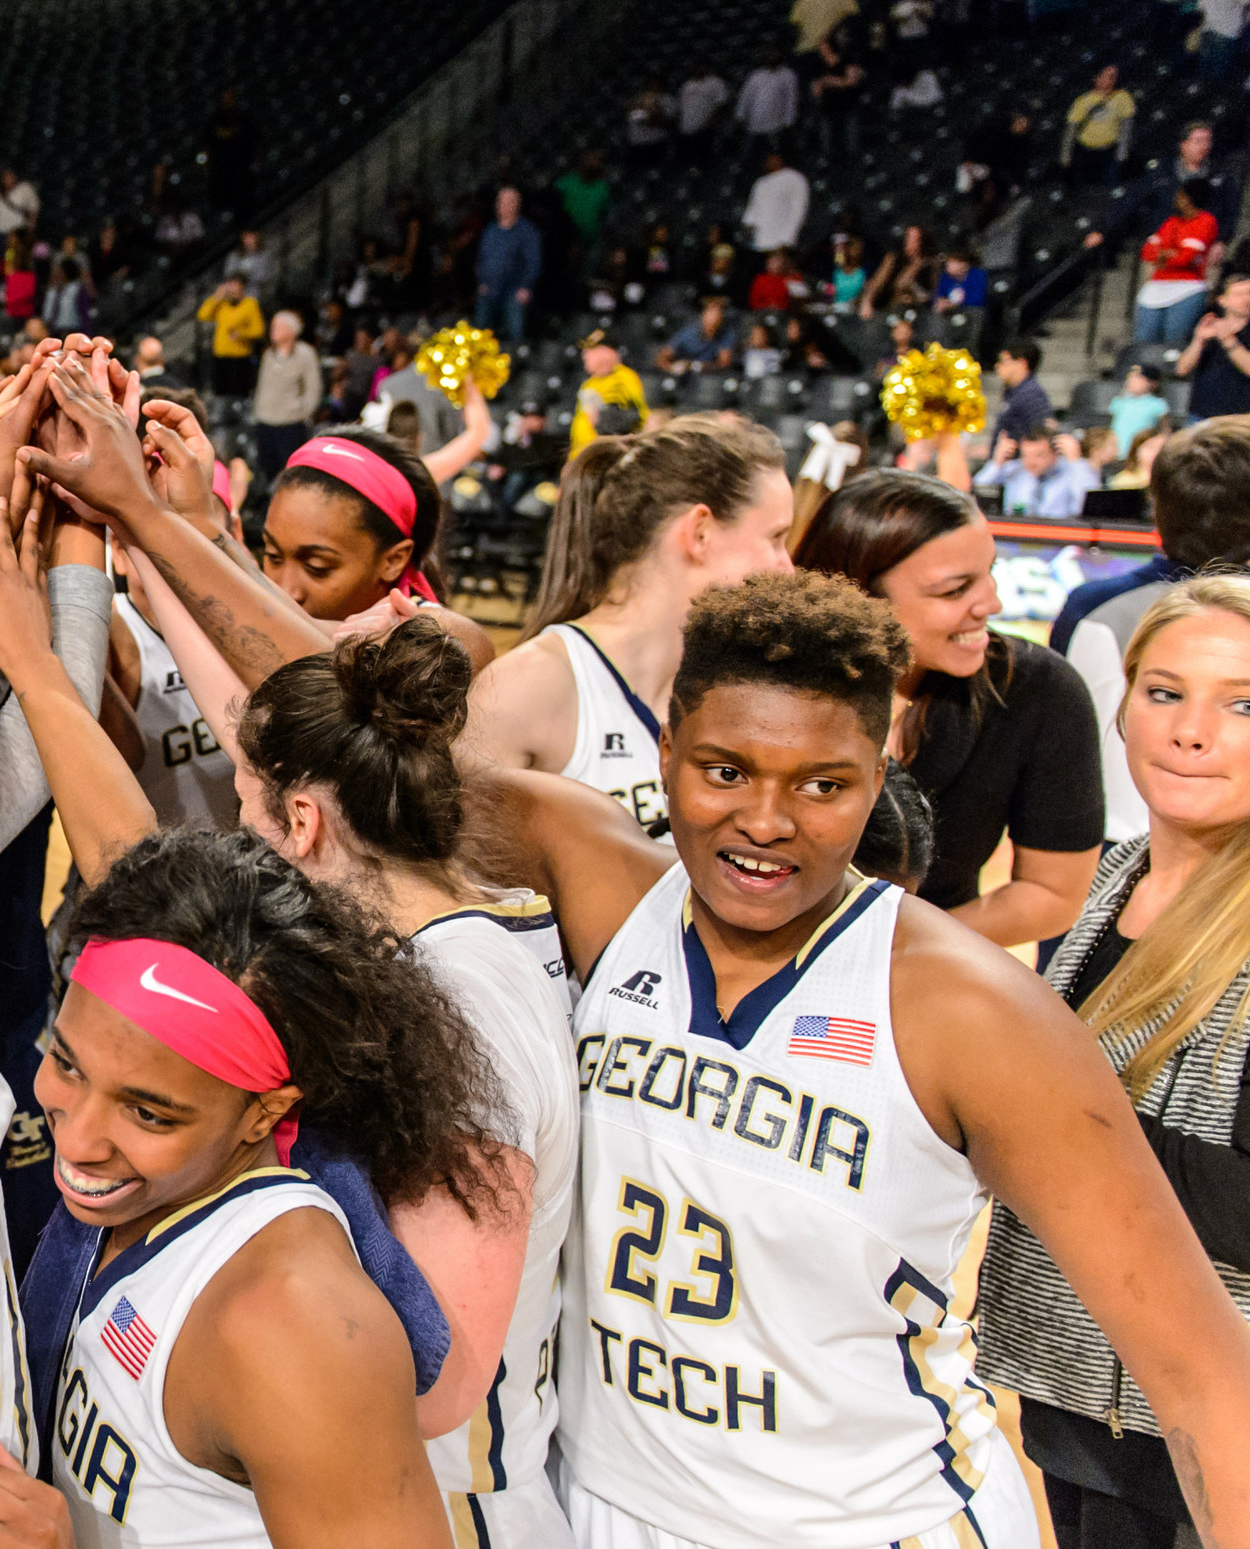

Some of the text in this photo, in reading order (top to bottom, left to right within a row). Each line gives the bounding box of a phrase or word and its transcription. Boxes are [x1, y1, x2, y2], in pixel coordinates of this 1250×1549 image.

[608, 987, 659, 1010] RUSSELL
[621, 970, 662, 996] R
[576, 1032, 873, 1194] GEORGIA
[604, 1175, 740, 1328] 23
[590, 1316, 780, 1434] TECH
